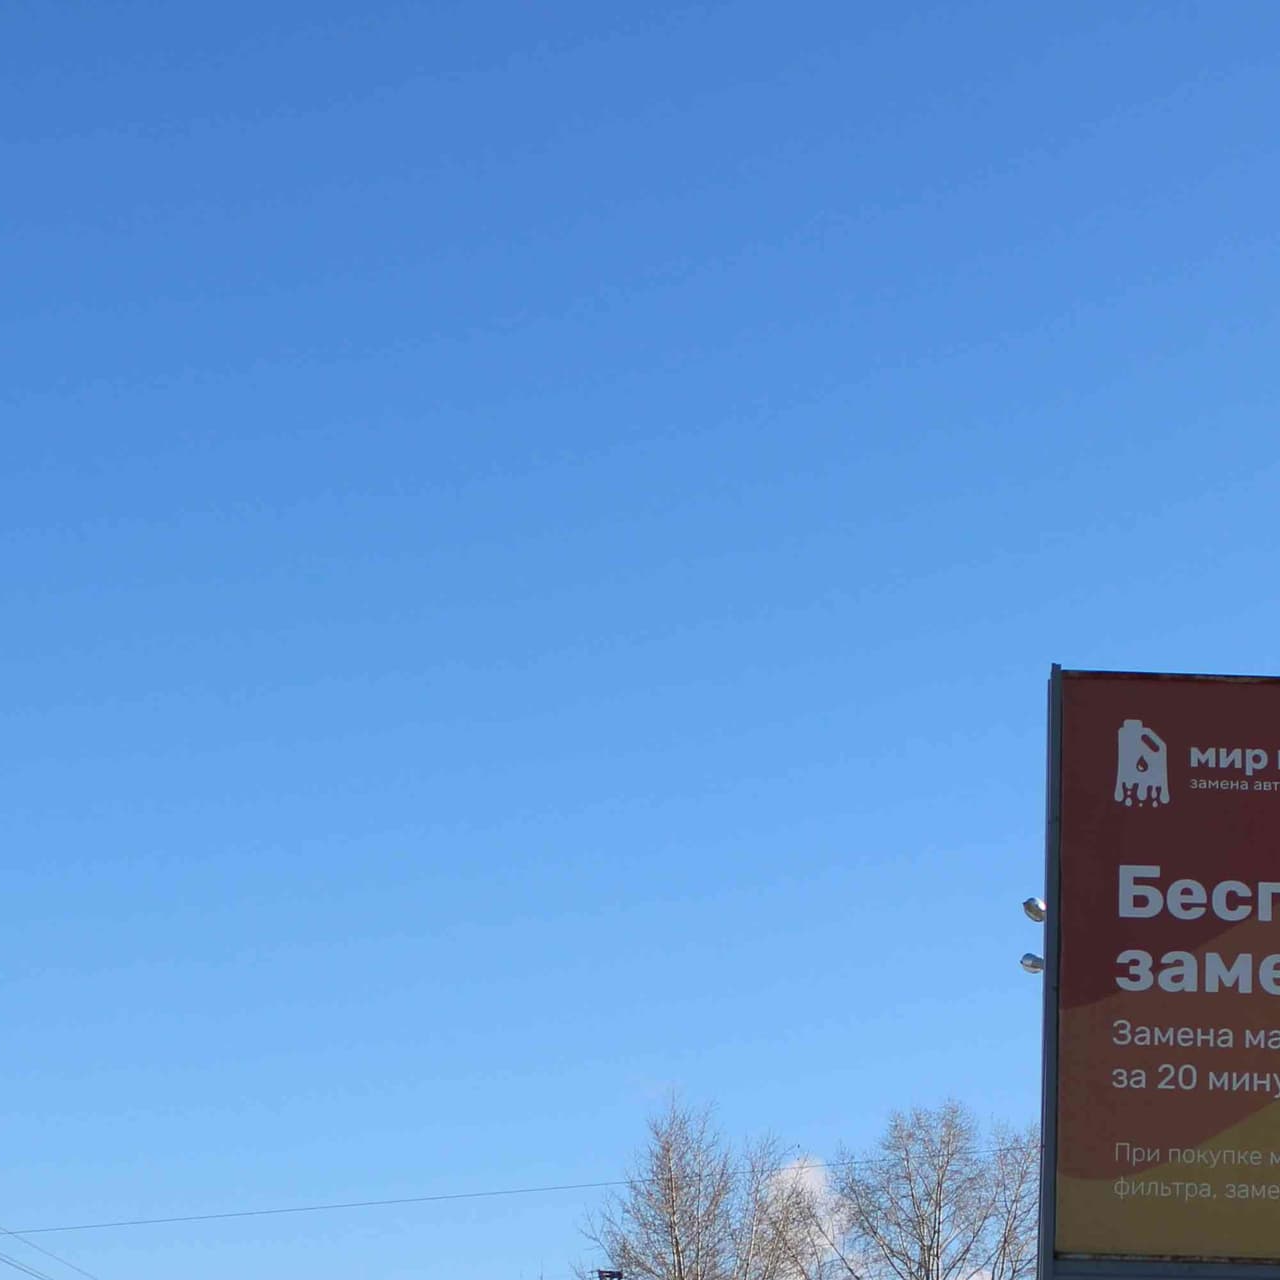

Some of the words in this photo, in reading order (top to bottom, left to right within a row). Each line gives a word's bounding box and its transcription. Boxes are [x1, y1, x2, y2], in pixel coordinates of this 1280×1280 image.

[1191, 747, 1268, 775] мир
[1189, 778, 1251, 791] замена
[1113, 1020, 1233, 1047] Замена
[1113, 1069, 1145, 1088] за
[1158, 1064, 1196, 1089] 20
[1116, 1143, 1159, 1166] При
[1169, 1149, 1262, 1168] покупке
